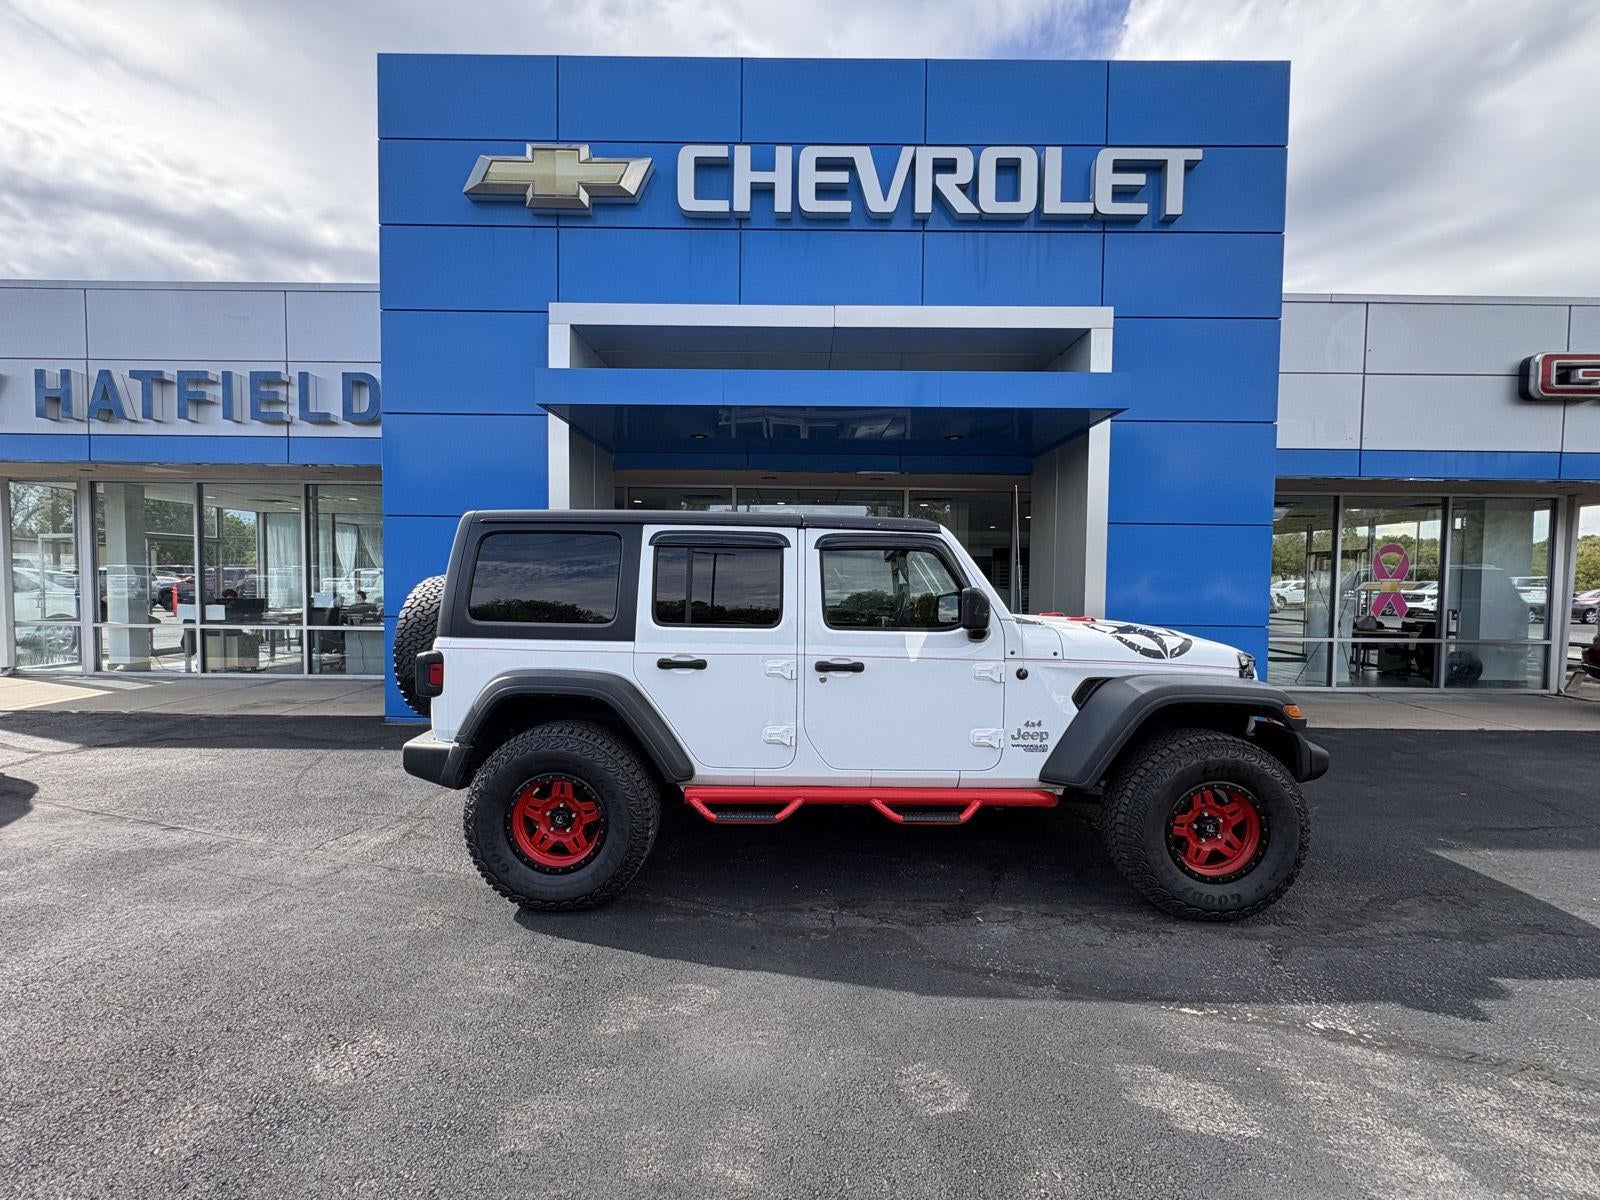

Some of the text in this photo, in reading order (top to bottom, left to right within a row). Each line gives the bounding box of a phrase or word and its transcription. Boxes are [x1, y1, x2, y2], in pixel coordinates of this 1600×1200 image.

[677, 144, 1203, 219] CHEVROLET
[34, 368, 382, 425] HATFIELD
[1010, 728, 1049, 742] Jeep
[1024, 719, 1042, 728] 4x4
